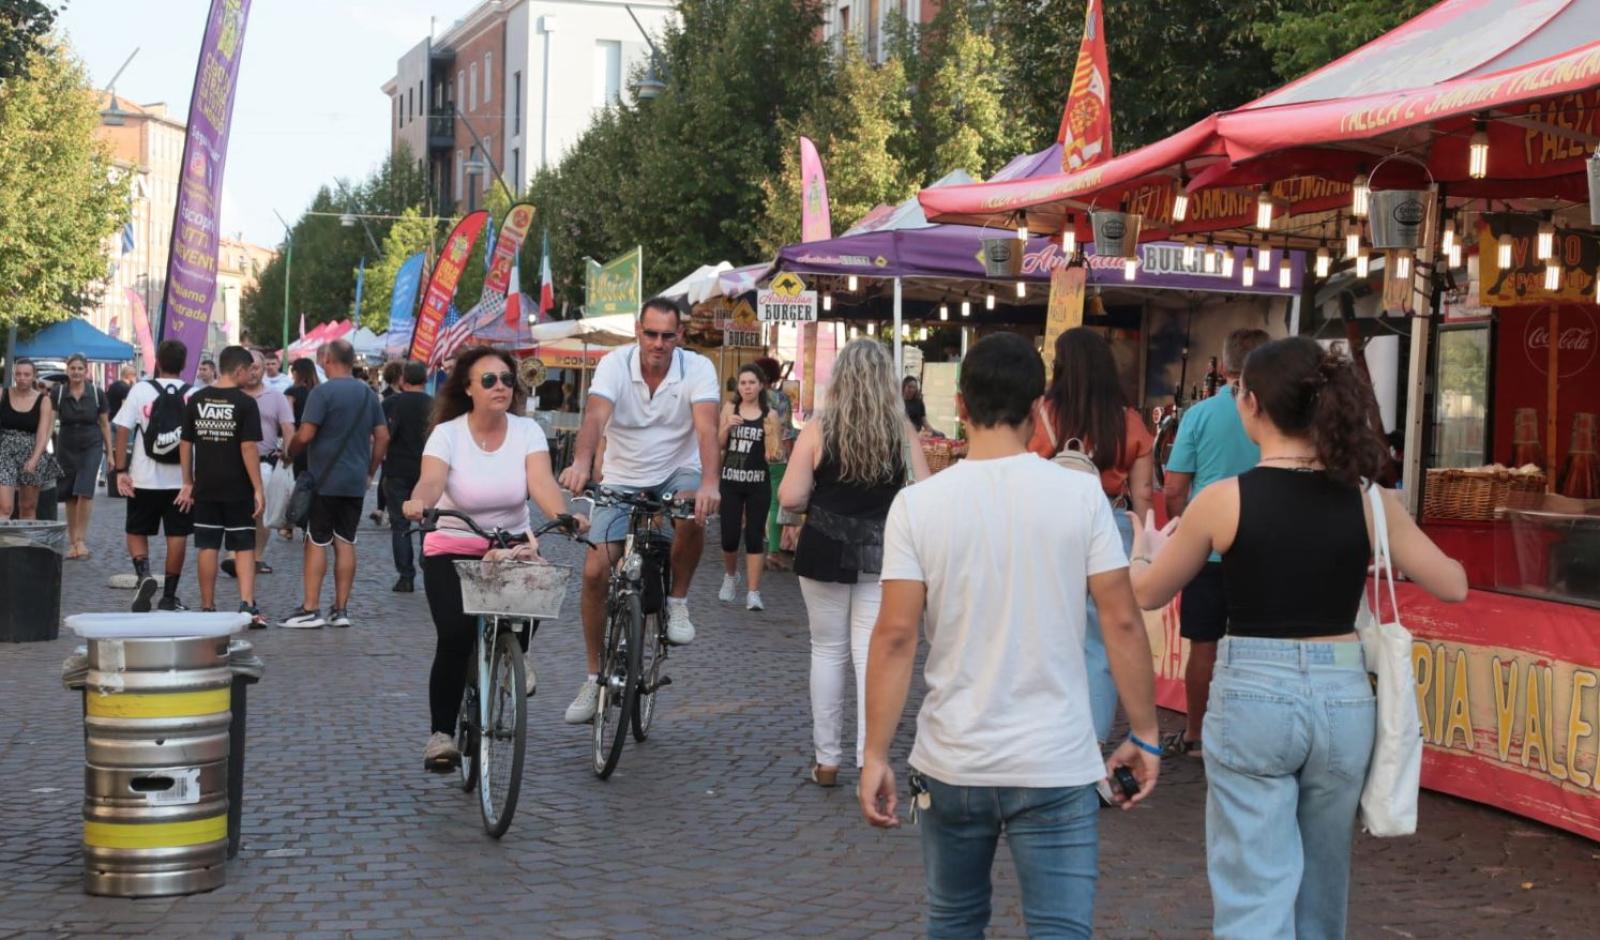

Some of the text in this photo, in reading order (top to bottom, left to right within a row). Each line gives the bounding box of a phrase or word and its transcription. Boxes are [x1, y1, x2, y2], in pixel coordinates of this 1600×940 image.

[1512, 235, 1582, 268] VIO
[765, 304, 812, 320] BURGER
[197, 403, 235, 419] VANS
[1492, 656, 1600, 791] VALE
